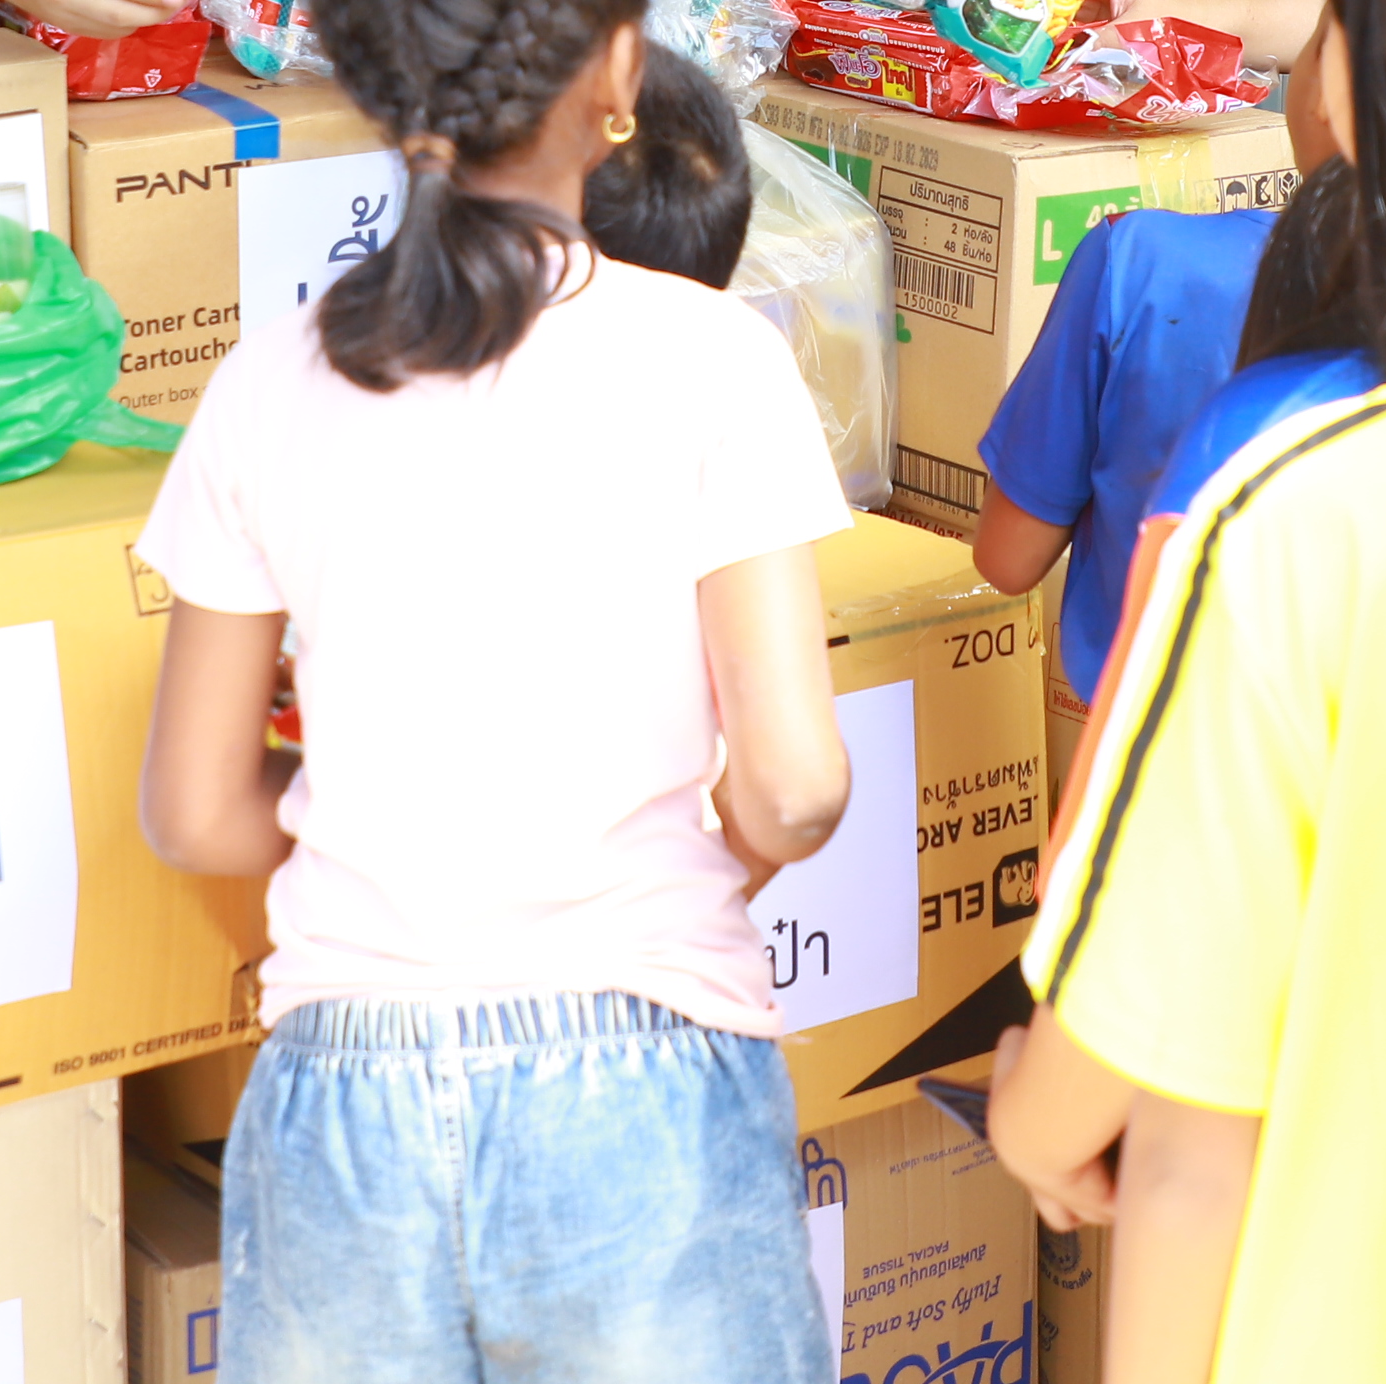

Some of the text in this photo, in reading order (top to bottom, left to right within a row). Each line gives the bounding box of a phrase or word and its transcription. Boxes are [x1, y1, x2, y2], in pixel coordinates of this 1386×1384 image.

[116, 160, 252, 203] PANT
[909, 180, 970, 213] ปริมาณสุทธิ
[881, 203, 904, 224] บรรจุ
[951, 222, 958, 235] 2
[944, 239, 956, 253] 48
[1042, 219, 1063, 262] L
[904, 291, 958, 320] 1500002
[168, 385, 199, 403] box
[921, 881, 985, 933] ELE
[54, 1056, 84, 1075] ISO
[89, 1047, 127, 1068] 9001
[132, 1021, 223, 1058] CERTIFIED
[863, 1240, 949, 1279] FACIAL TISSUE
[951, 1274, 1002, 1315] Fluffy
[906, 1299, 946, 1331] Soft
[861, 1317, 902, 1349] and
